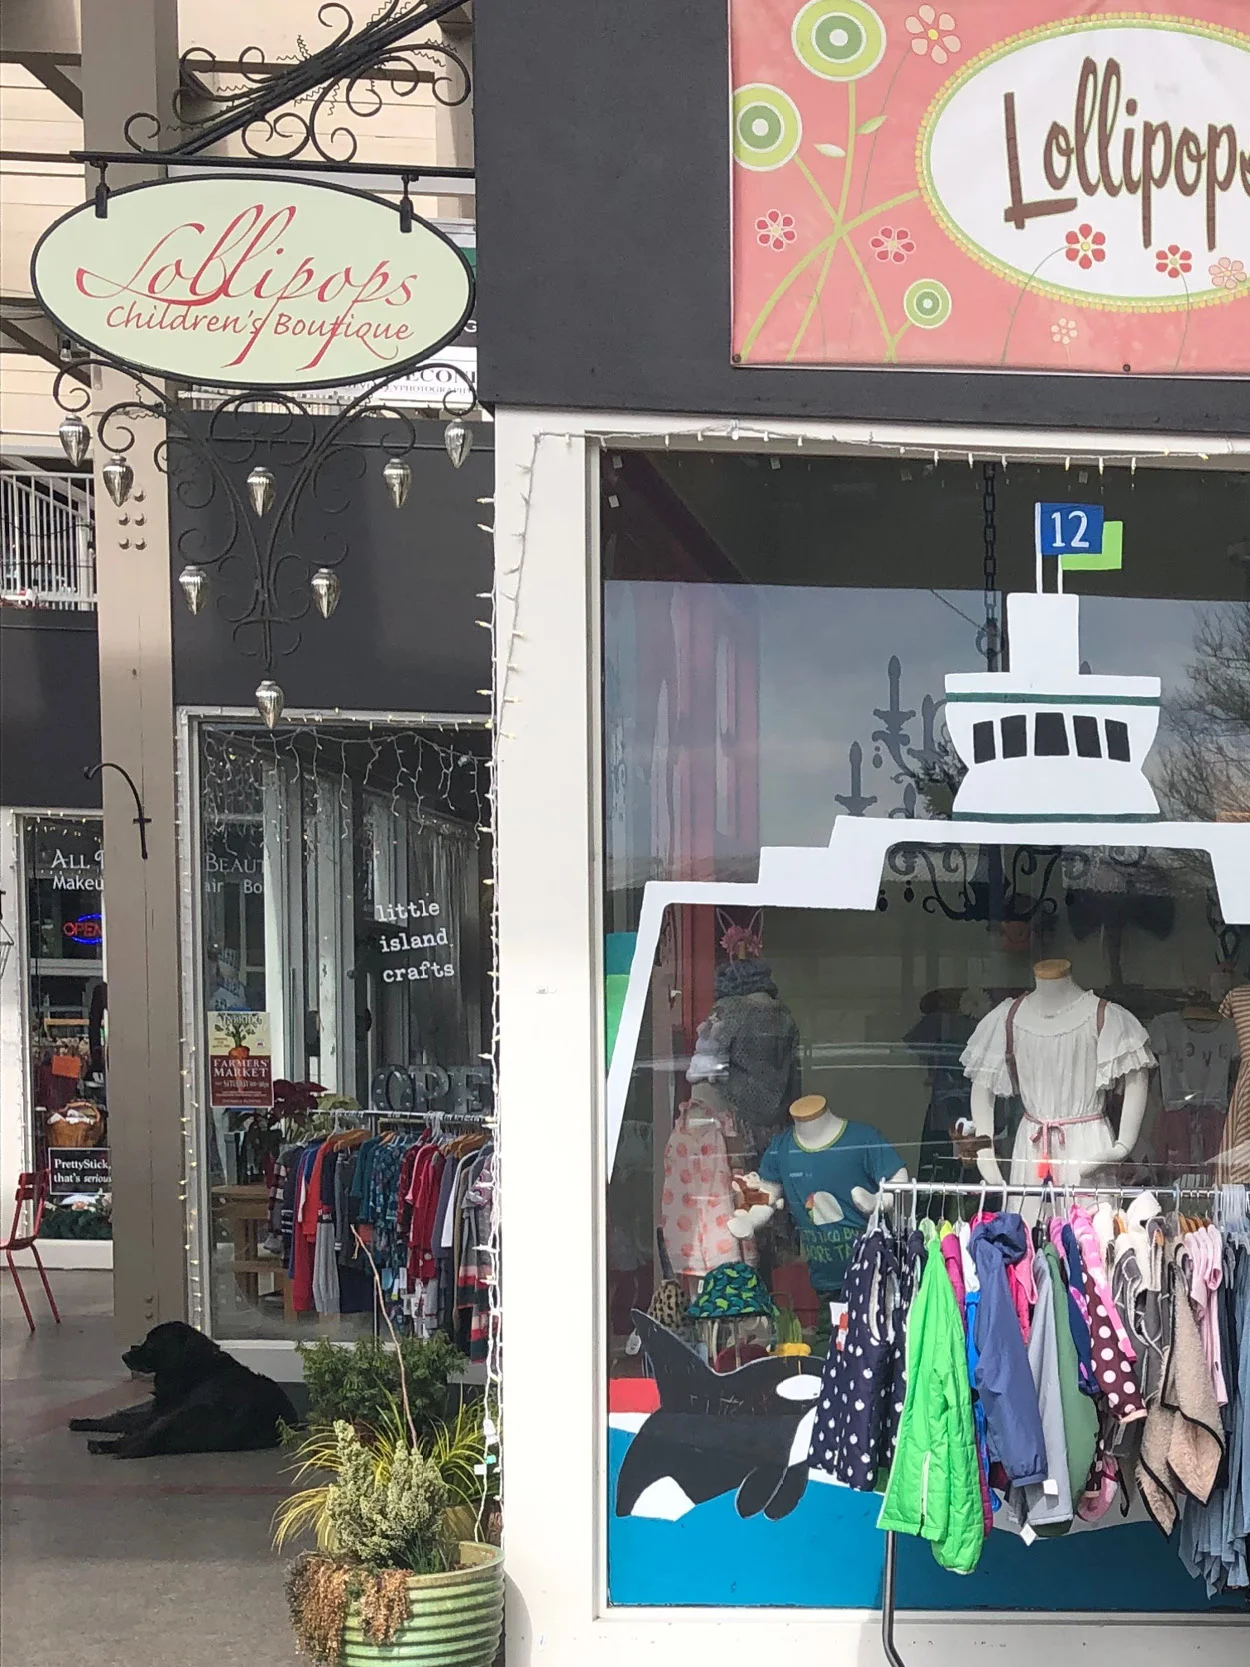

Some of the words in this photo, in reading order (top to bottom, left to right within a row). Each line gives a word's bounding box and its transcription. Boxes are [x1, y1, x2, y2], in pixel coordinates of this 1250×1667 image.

[75, 203, 418, 372] Lollipops
[106, 300, 262, 336] Children's
[273, 313, 415, 360] Boutique
[1051, 510, 1090, 548] 12
[51, 849, 90, 869] ALL
[375, 899, 440, 922] little
[379, 927, 449, 952] island
[383, 961, 455, 983] crafts
[213, 1067, 269, 1078] MARKET
[53, 1172, 81, 1183] that's
